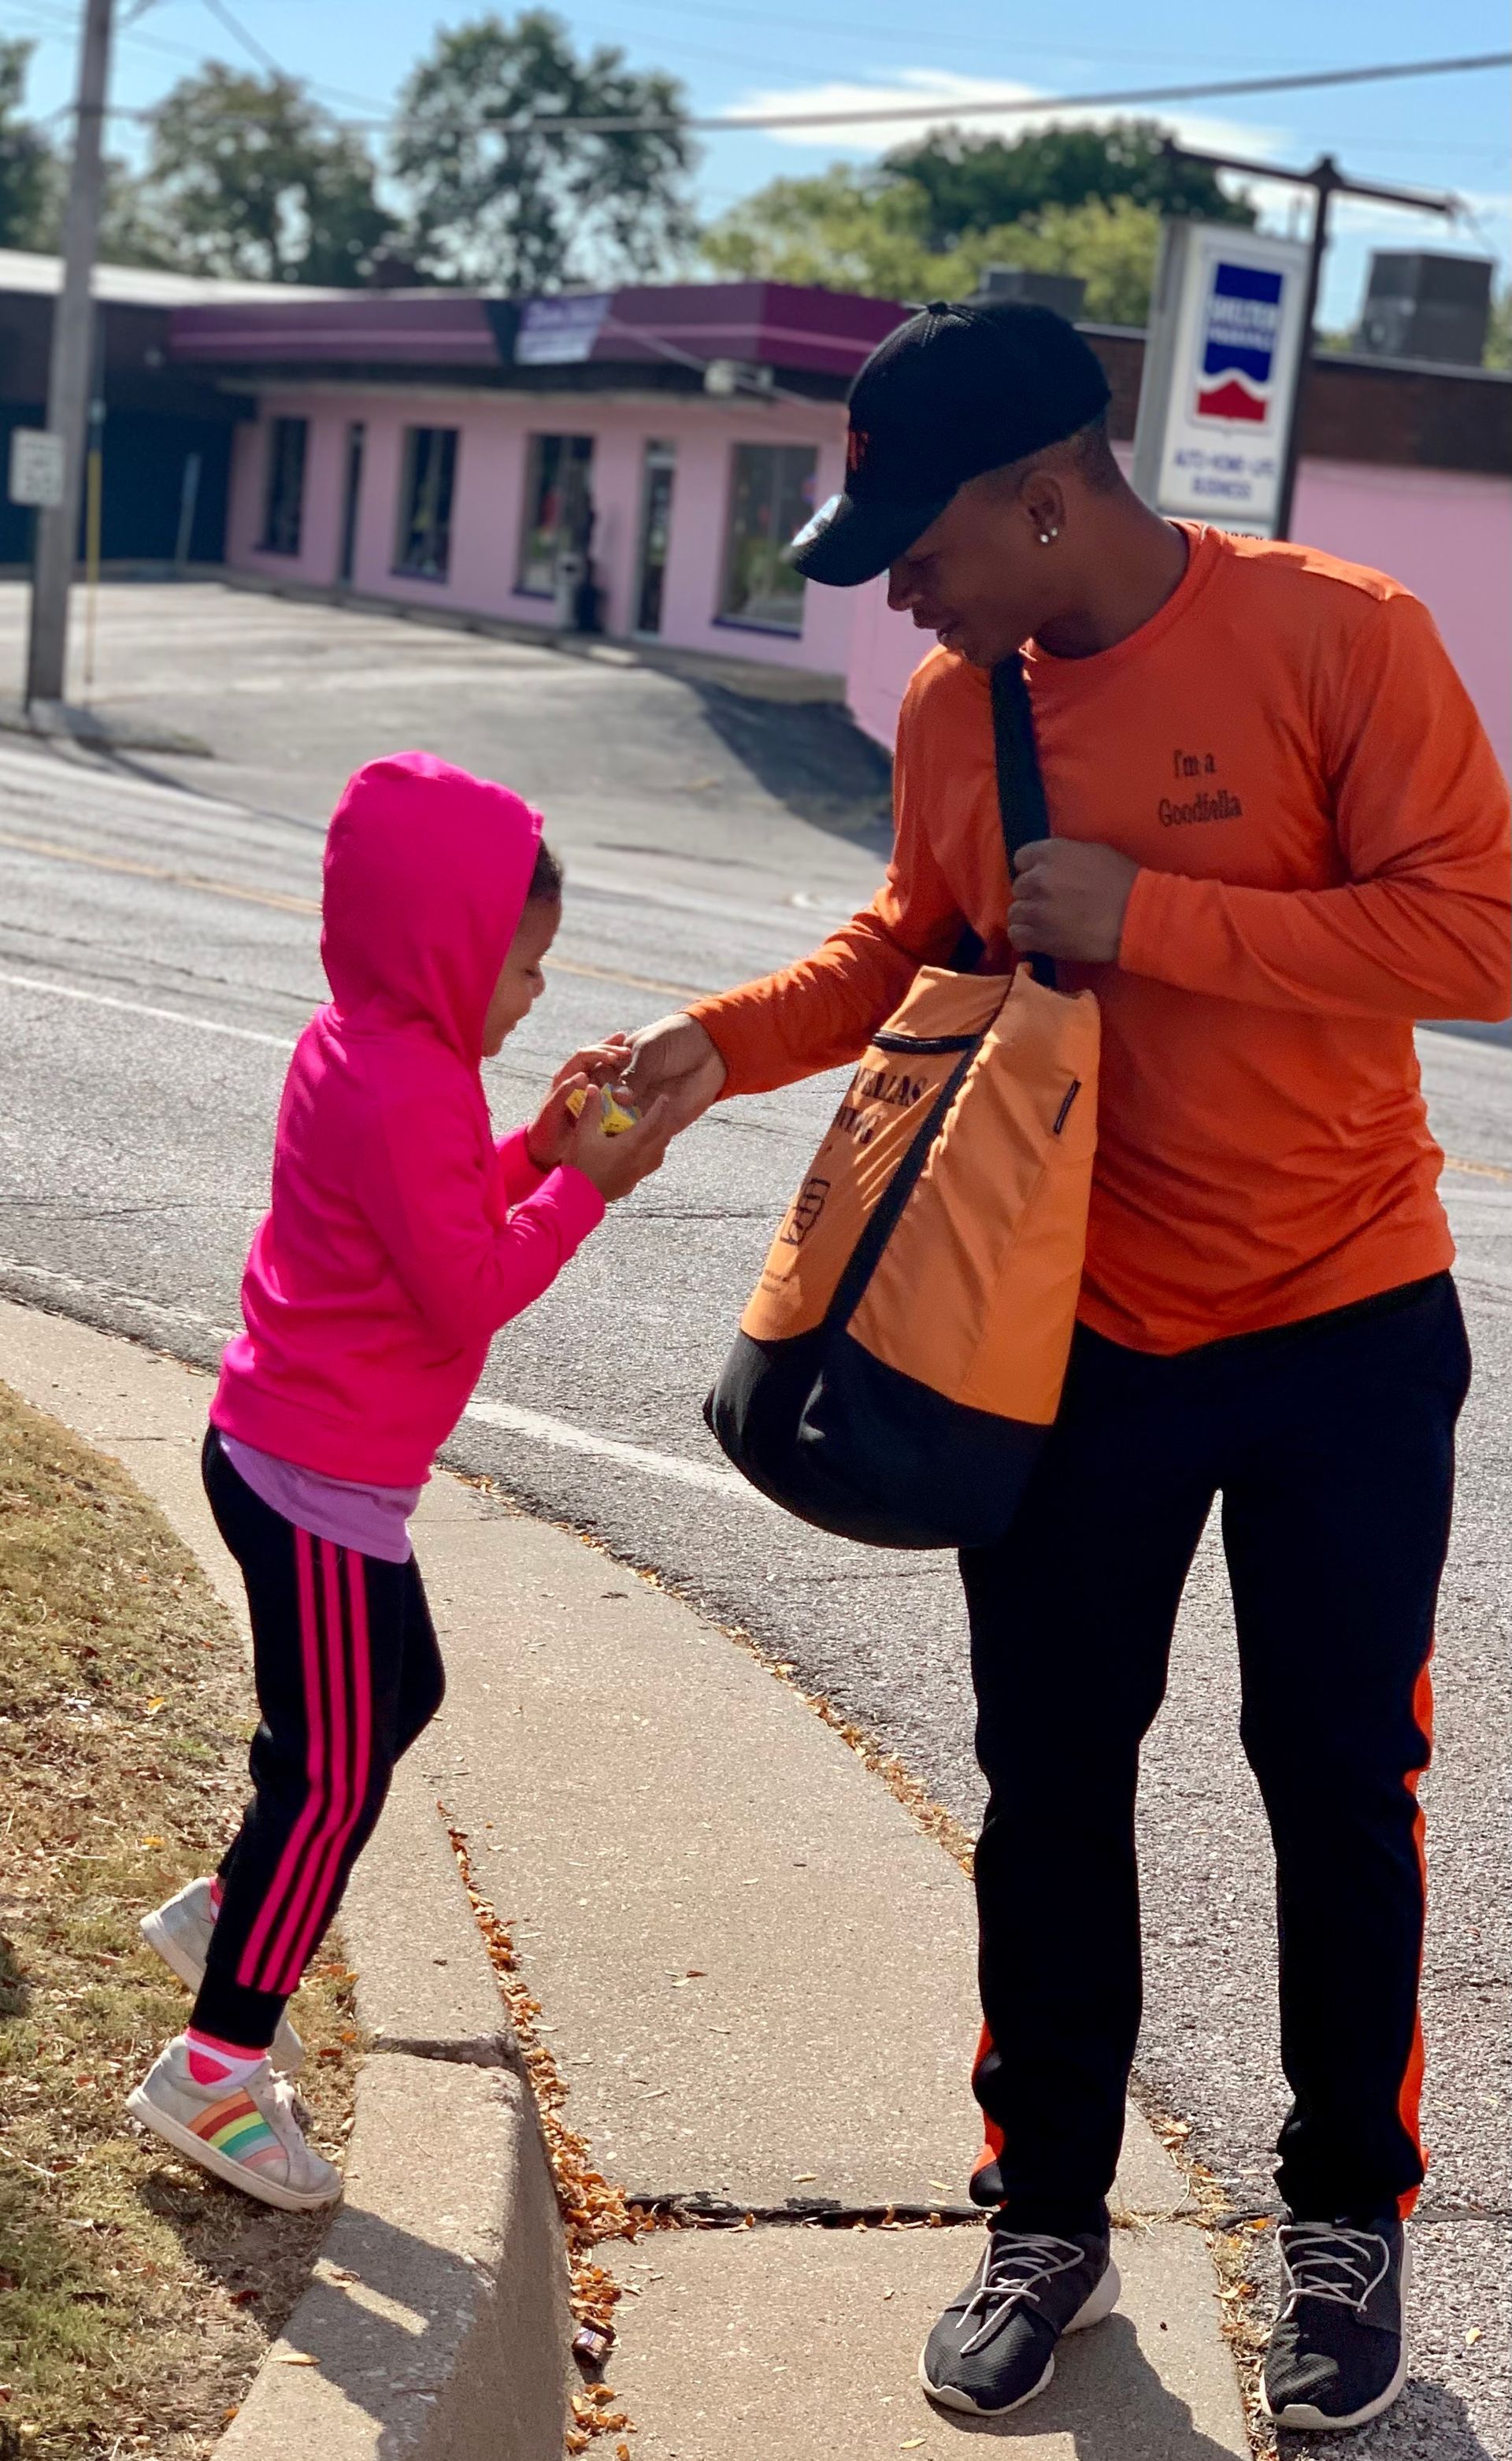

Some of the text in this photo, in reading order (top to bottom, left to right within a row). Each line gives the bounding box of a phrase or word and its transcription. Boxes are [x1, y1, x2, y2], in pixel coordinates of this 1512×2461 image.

[1174, 750, 1215, 778] I'm a
[1159, 790, 1242, 827] Goodfella
